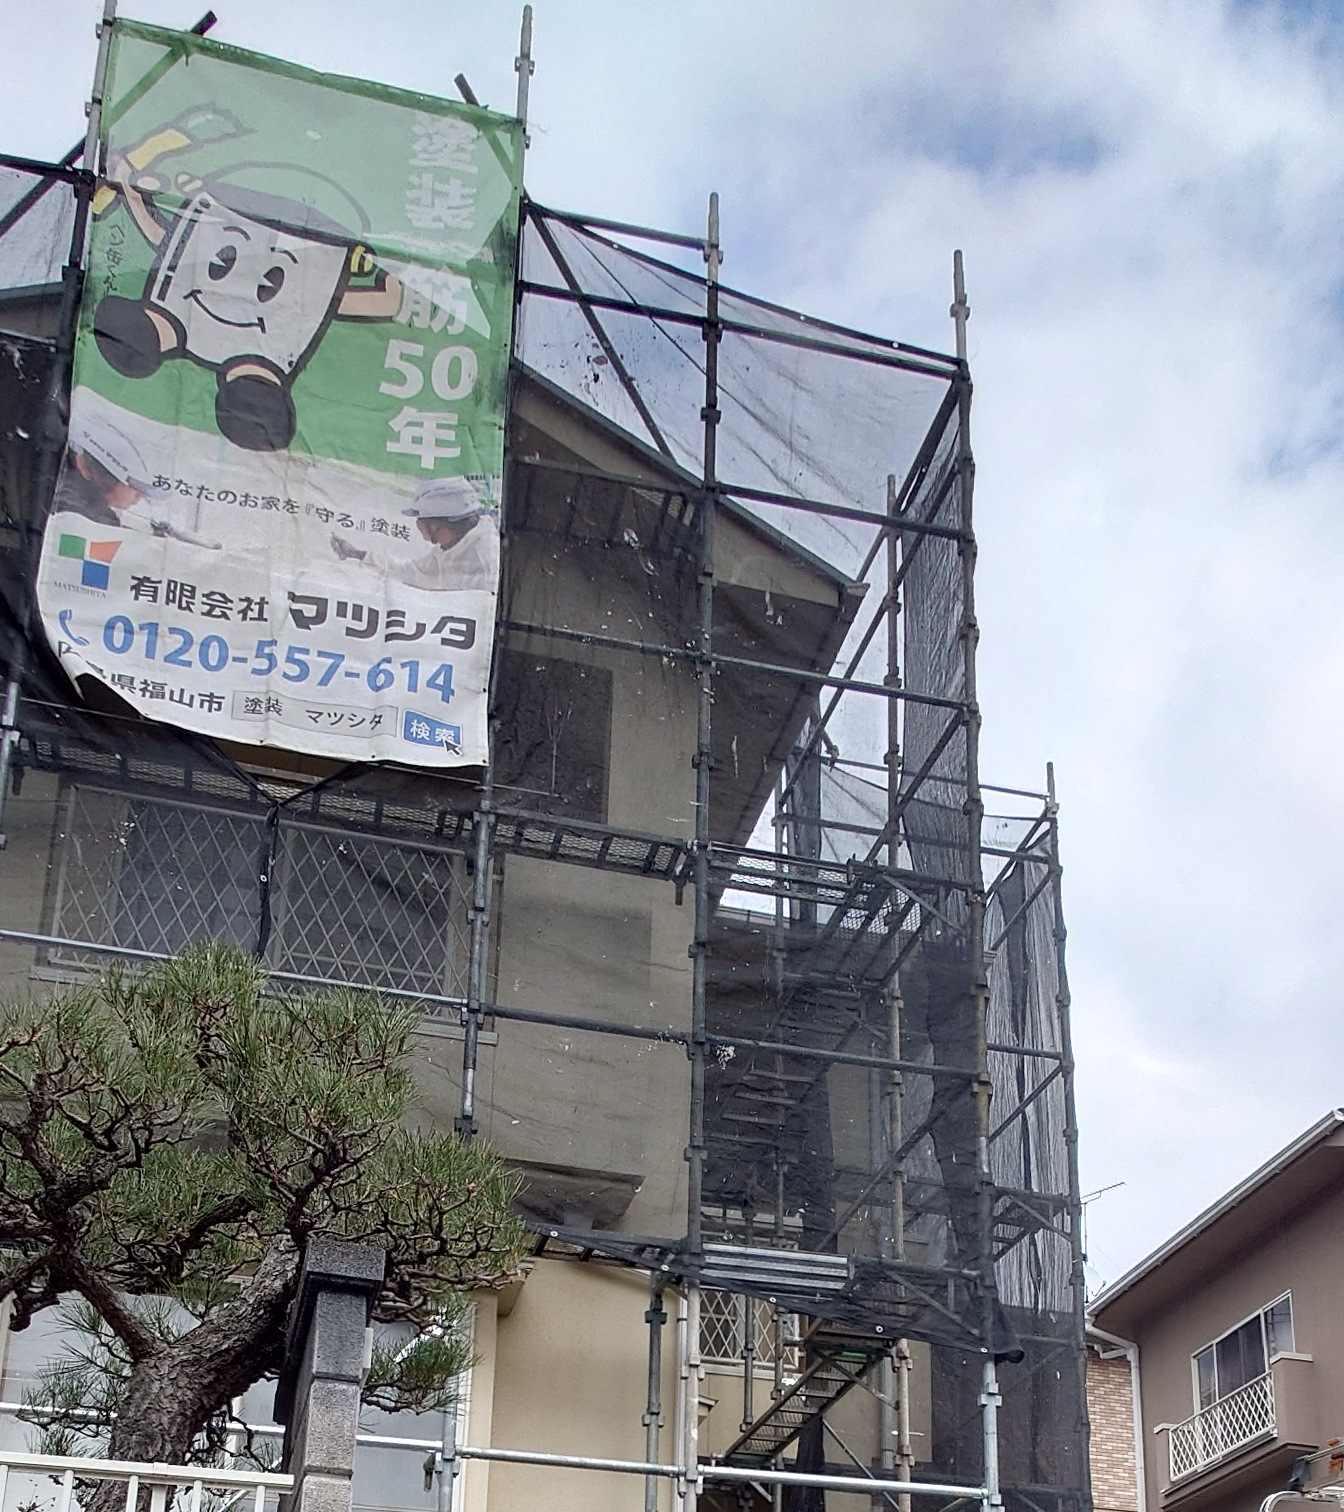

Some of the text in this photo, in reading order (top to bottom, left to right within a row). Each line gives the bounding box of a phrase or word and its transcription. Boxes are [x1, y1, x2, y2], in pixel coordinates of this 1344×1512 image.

[53, 580, 107, 599] MATSUSHITA
[129, 574, 478, 651] 有限会社 マツシタ
[102, 614, 456, 704] 0120-557-614
[243, 695, 383, 731] 塗装 マツシタ
[410, 718, 456, 743] 検索
